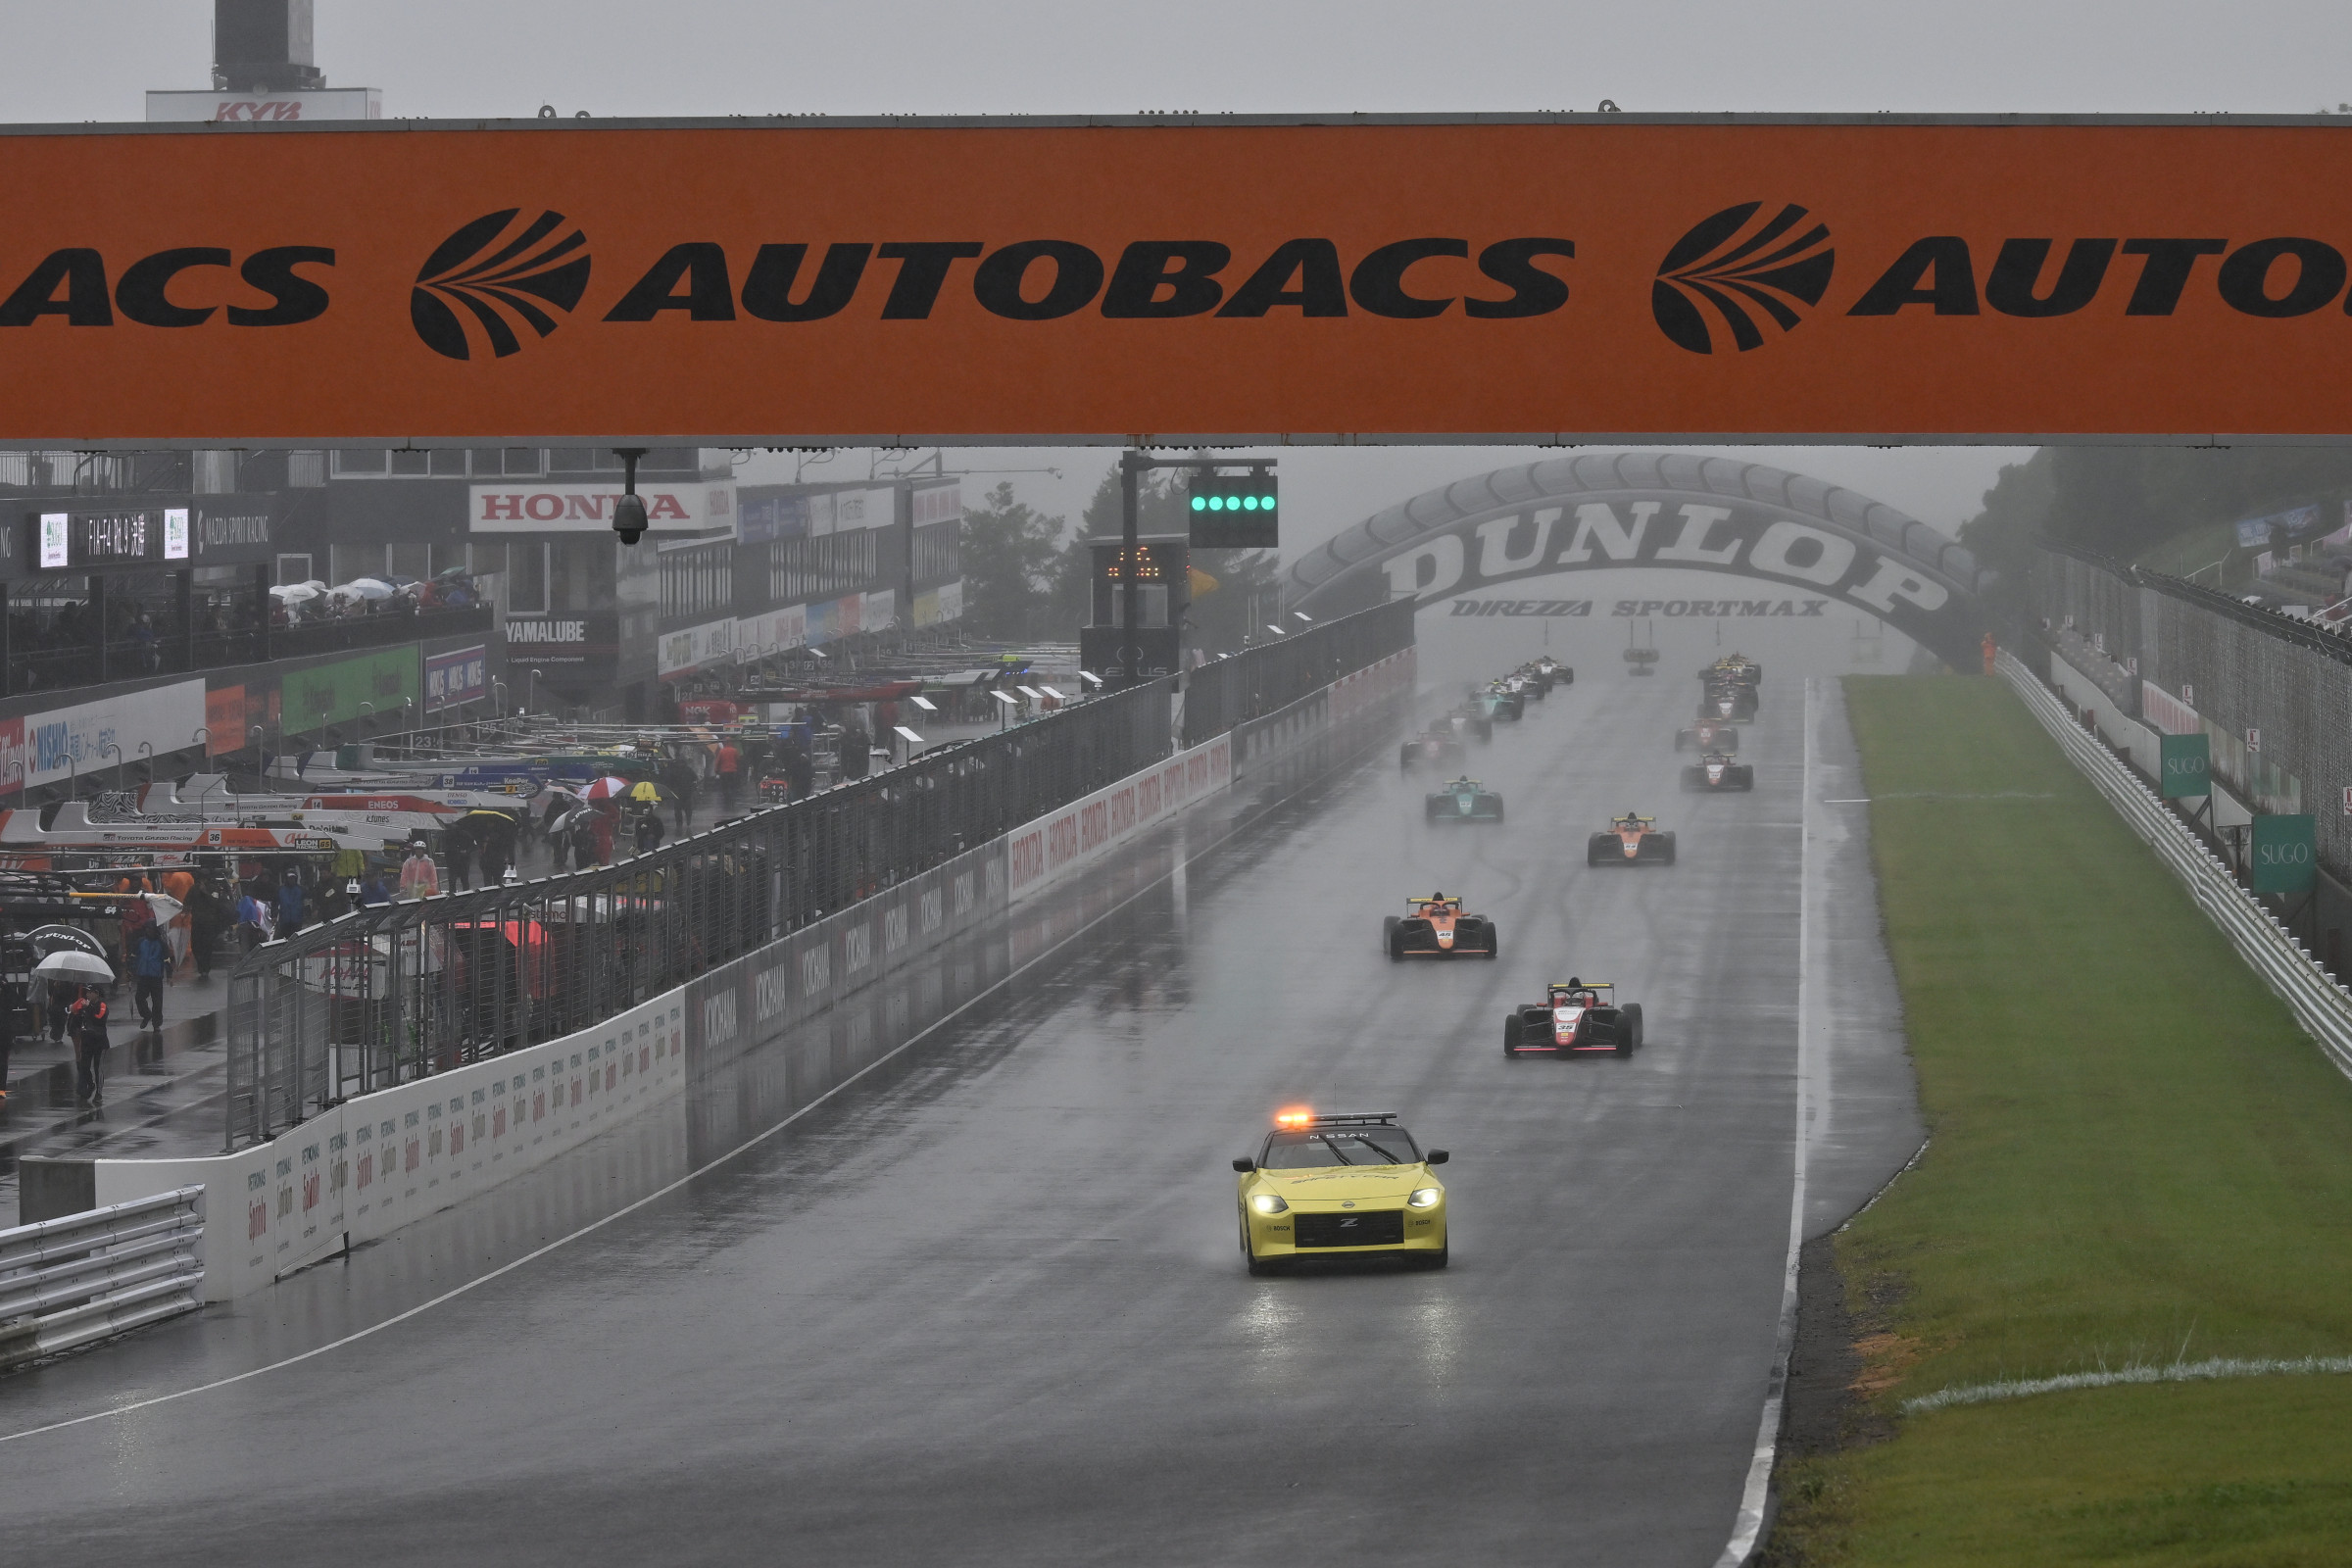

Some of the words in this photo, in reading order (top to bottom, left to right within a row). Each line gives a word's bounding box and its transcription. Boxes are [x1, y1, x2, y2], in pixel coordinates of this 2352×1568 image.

[216, 102, 302, 121] KYB
[0, 245, 336, 328] ACS
[601, 237, 1575, 322] AUTOBACS
[1844, 236, 2352, 318] AUTO
[206, 517, 227, 546] MAZDA
[228, 517, 246, 544] SPIRIT
[247, 515, 269, 543] RACING
[1382, 501, 1948, 613] DUNLOP
[1447, 599, 1593, 617] DIREZZA
[1611, 599, 1829, 618] SPORTMAX
[506, 620, 585, 643] YAMALUBE
[511, 656, 529, 664] Liquid
[529, 656, 550, 664] Engine
[1092, 667, 1167, 677] LEUS
[37, 721, 69, 772] NISHIO
[2168, 756, 2205, 775] SUGO
[368, 801, 399, 809] ENEOS
[210, 832, 220, 842] 36
[1081, 800, 1108, 854] HONDA
[1049, 812, 1078, 870] HONDA
[1012, 830, 1044, 891] HONDA
[2261, 843, 2308, 865] SUGO
[104, 906, 117, 915] 64
[43, 932, 91, 950] DUNLOP
[756, 963, 785, 1024] YOKOHAMA
[705, 986, 737, 1051] YOKOHAMA
[276, 1156, 291, 1179] PETRONAS
[248, 1169, 266, 1192] PETRONAS
[249, 1196, 266, 1246] Sprinta
[1340, 1218, 1358, 1228] Z
